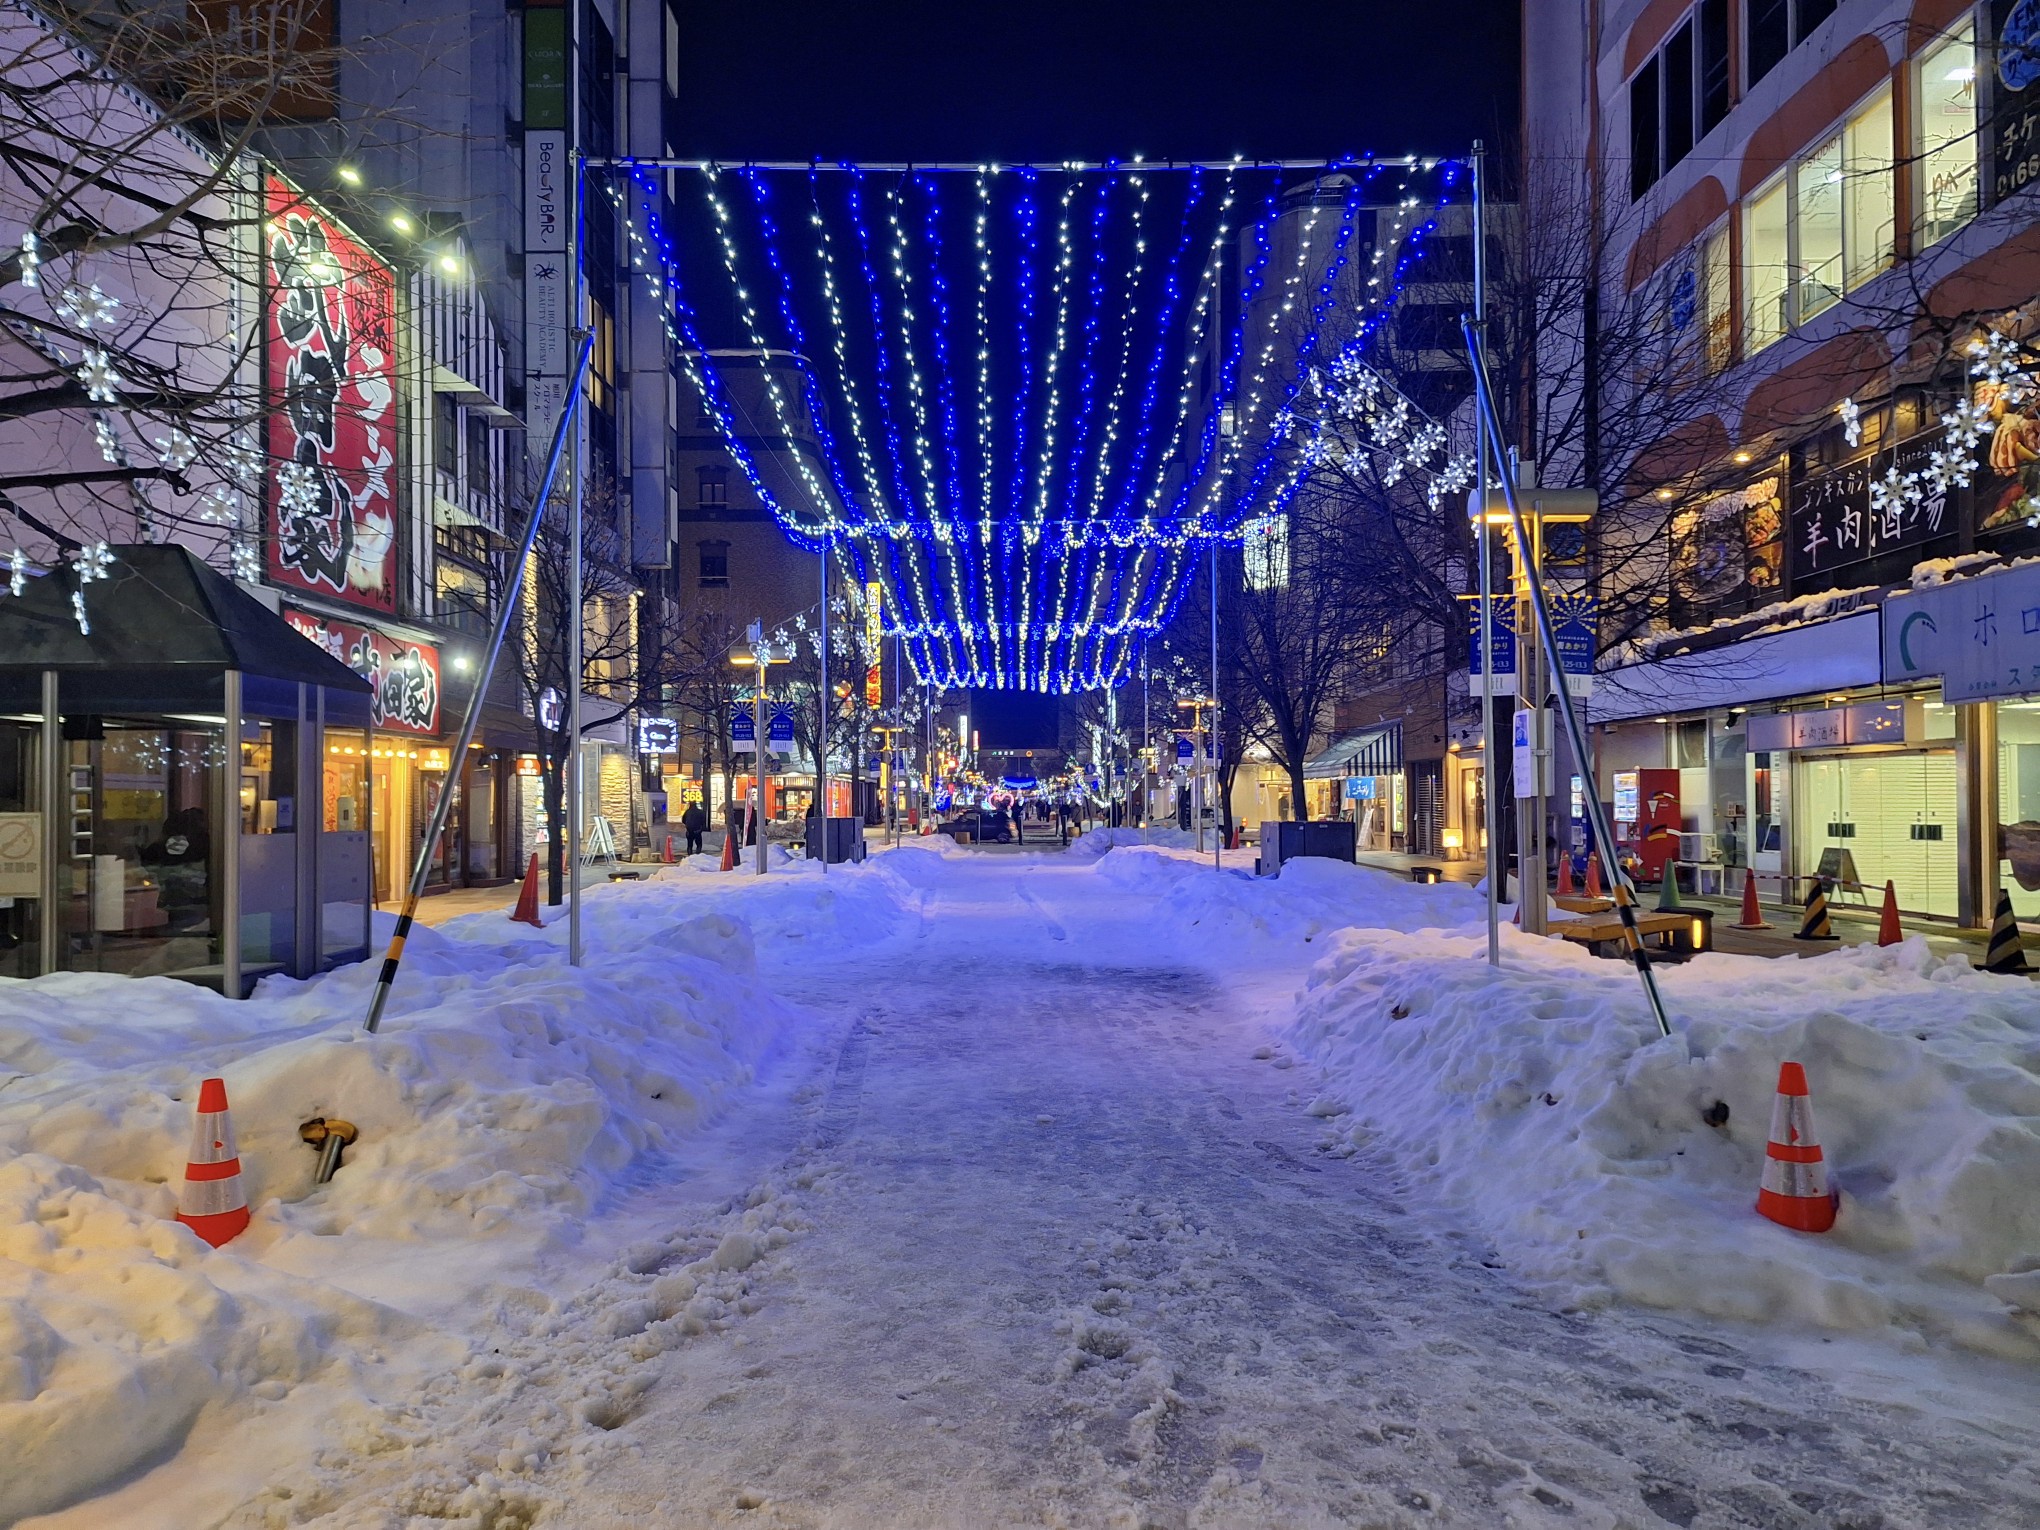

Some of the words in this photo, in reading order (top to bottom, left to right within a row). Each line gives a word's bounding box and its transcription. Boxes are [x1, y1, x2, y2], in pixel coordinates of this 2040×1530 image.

[539, 325, 547, 367] ACADEMY
[1803, 482, 1946, 569] 羊肉酒場
[1798, 724, 1840, 745] 羊肉酒場
